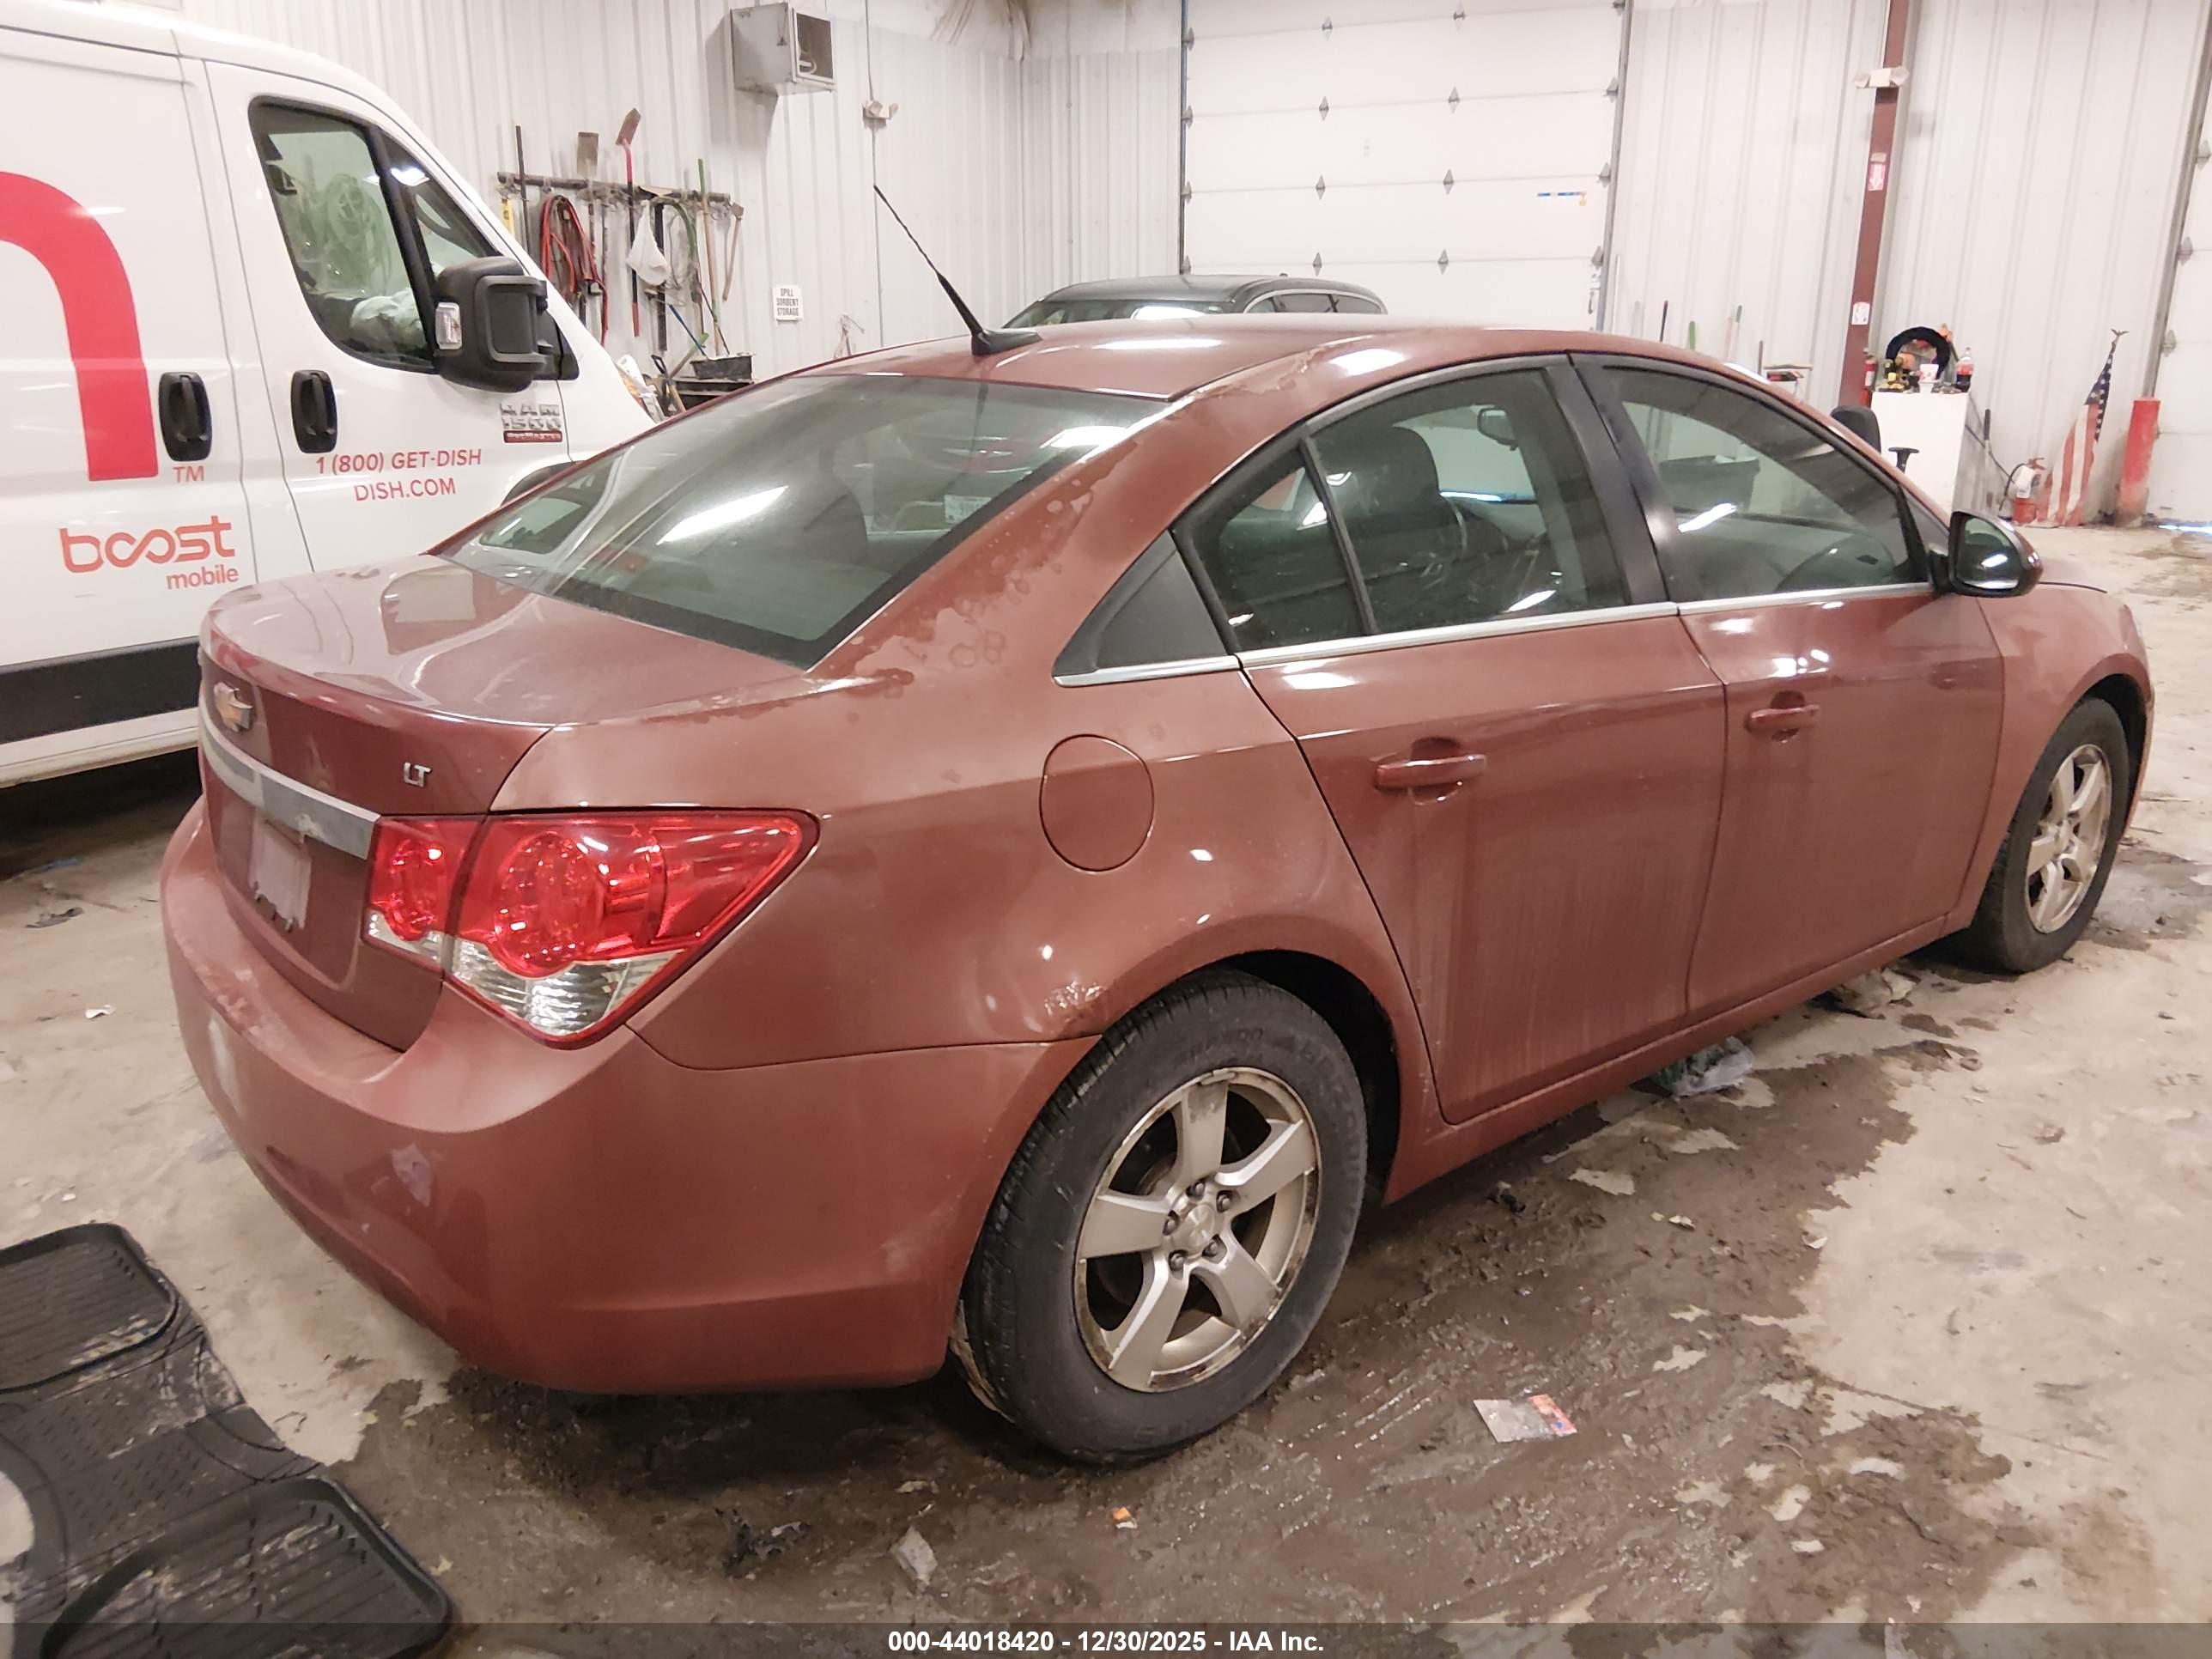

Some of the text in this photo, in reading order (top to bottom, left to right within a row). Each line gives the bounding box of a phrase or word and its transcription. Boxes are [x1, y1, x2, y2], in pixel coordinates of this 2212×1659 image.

[780, 288, 794, 297] SPILL
[776, 297, 799, 307] SORBENT
[777, 307, 799, 316] STORAGE
[500, 402, 560, 416] RAM
[501, 416, 562, 429] 1500
[316, 449, 482, 475] 1 (800) GET-DISH
[173, 465, 204, 483] TM
[354, 478, 456, 501] DISH.COM
[59, 515, 235, 573] boost
[166, 564, 239, 590] mobile
[403, 762, 432, 787] LT
